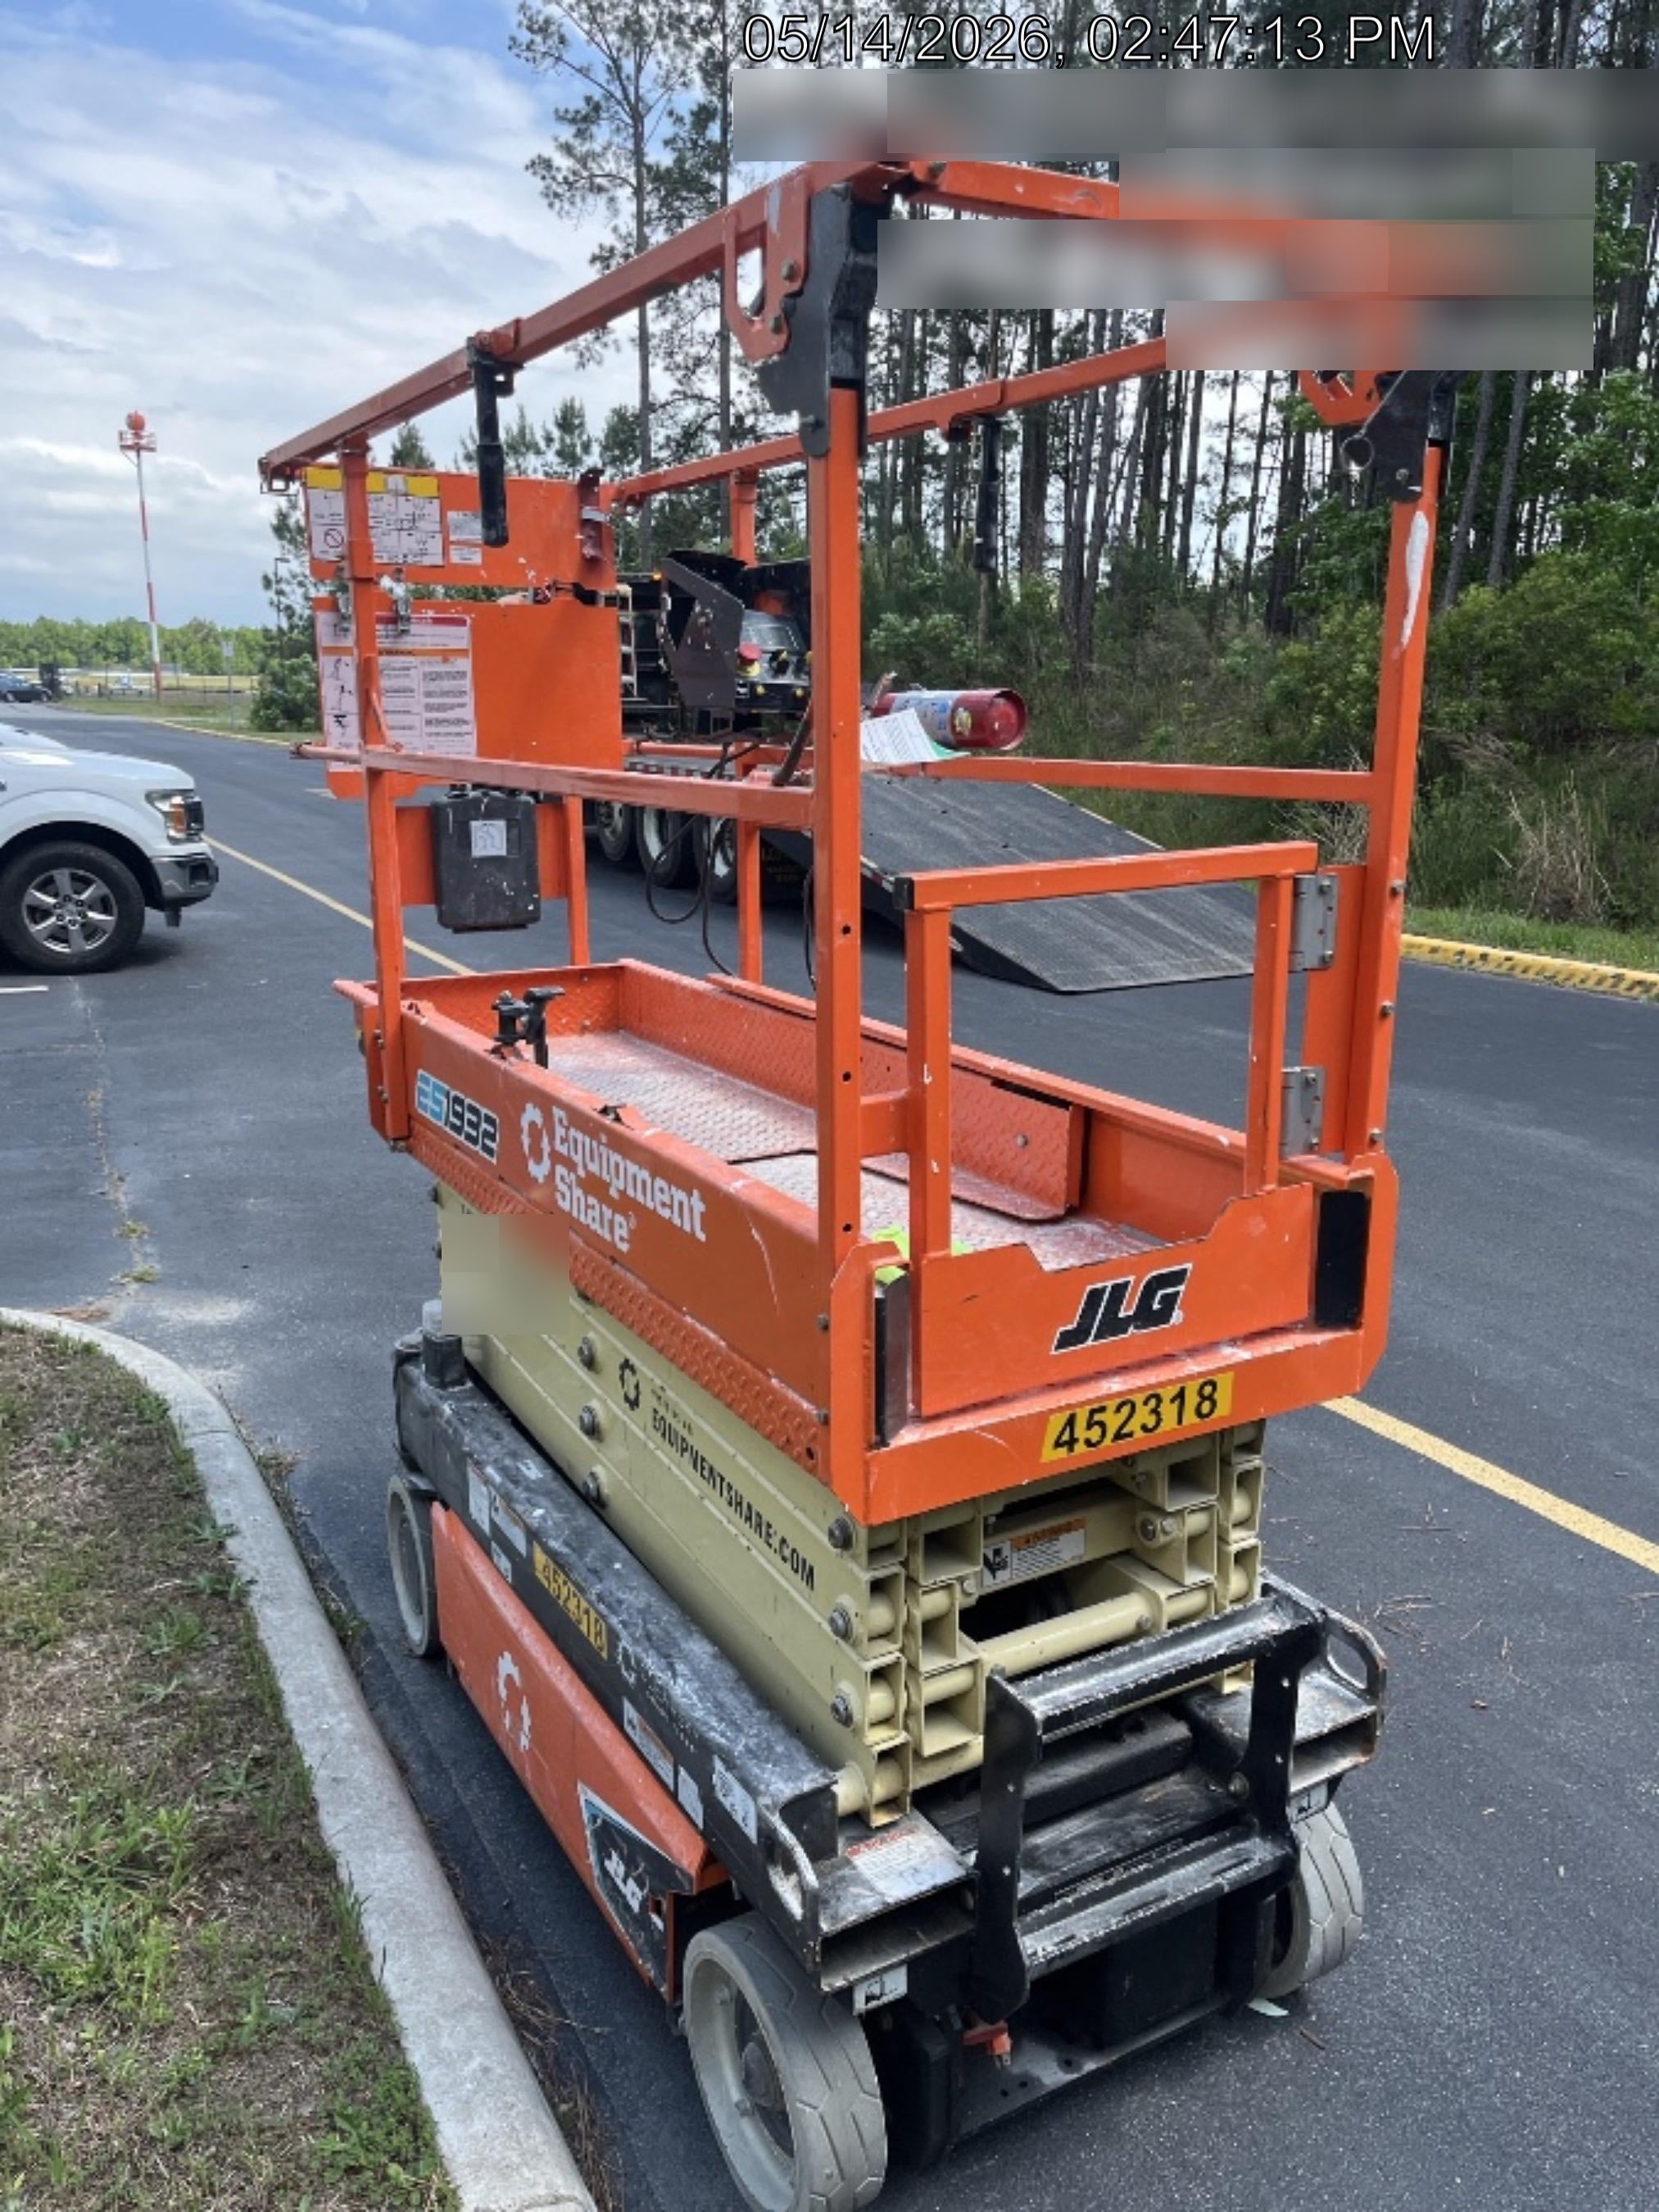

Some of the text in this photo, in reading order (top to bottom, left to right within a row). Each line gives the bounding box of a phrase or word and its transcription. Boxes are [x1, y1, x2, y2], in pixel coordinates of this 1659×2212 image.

[416, 1070, 500, 1163] ES1932
[552, 1105, 707, 1242] Equipment
[1050, 1263, 1193, 1354] JLG
[1053, 1379, 1217, 1453] 452318
[542, 1563, 605, 1652] 452318
